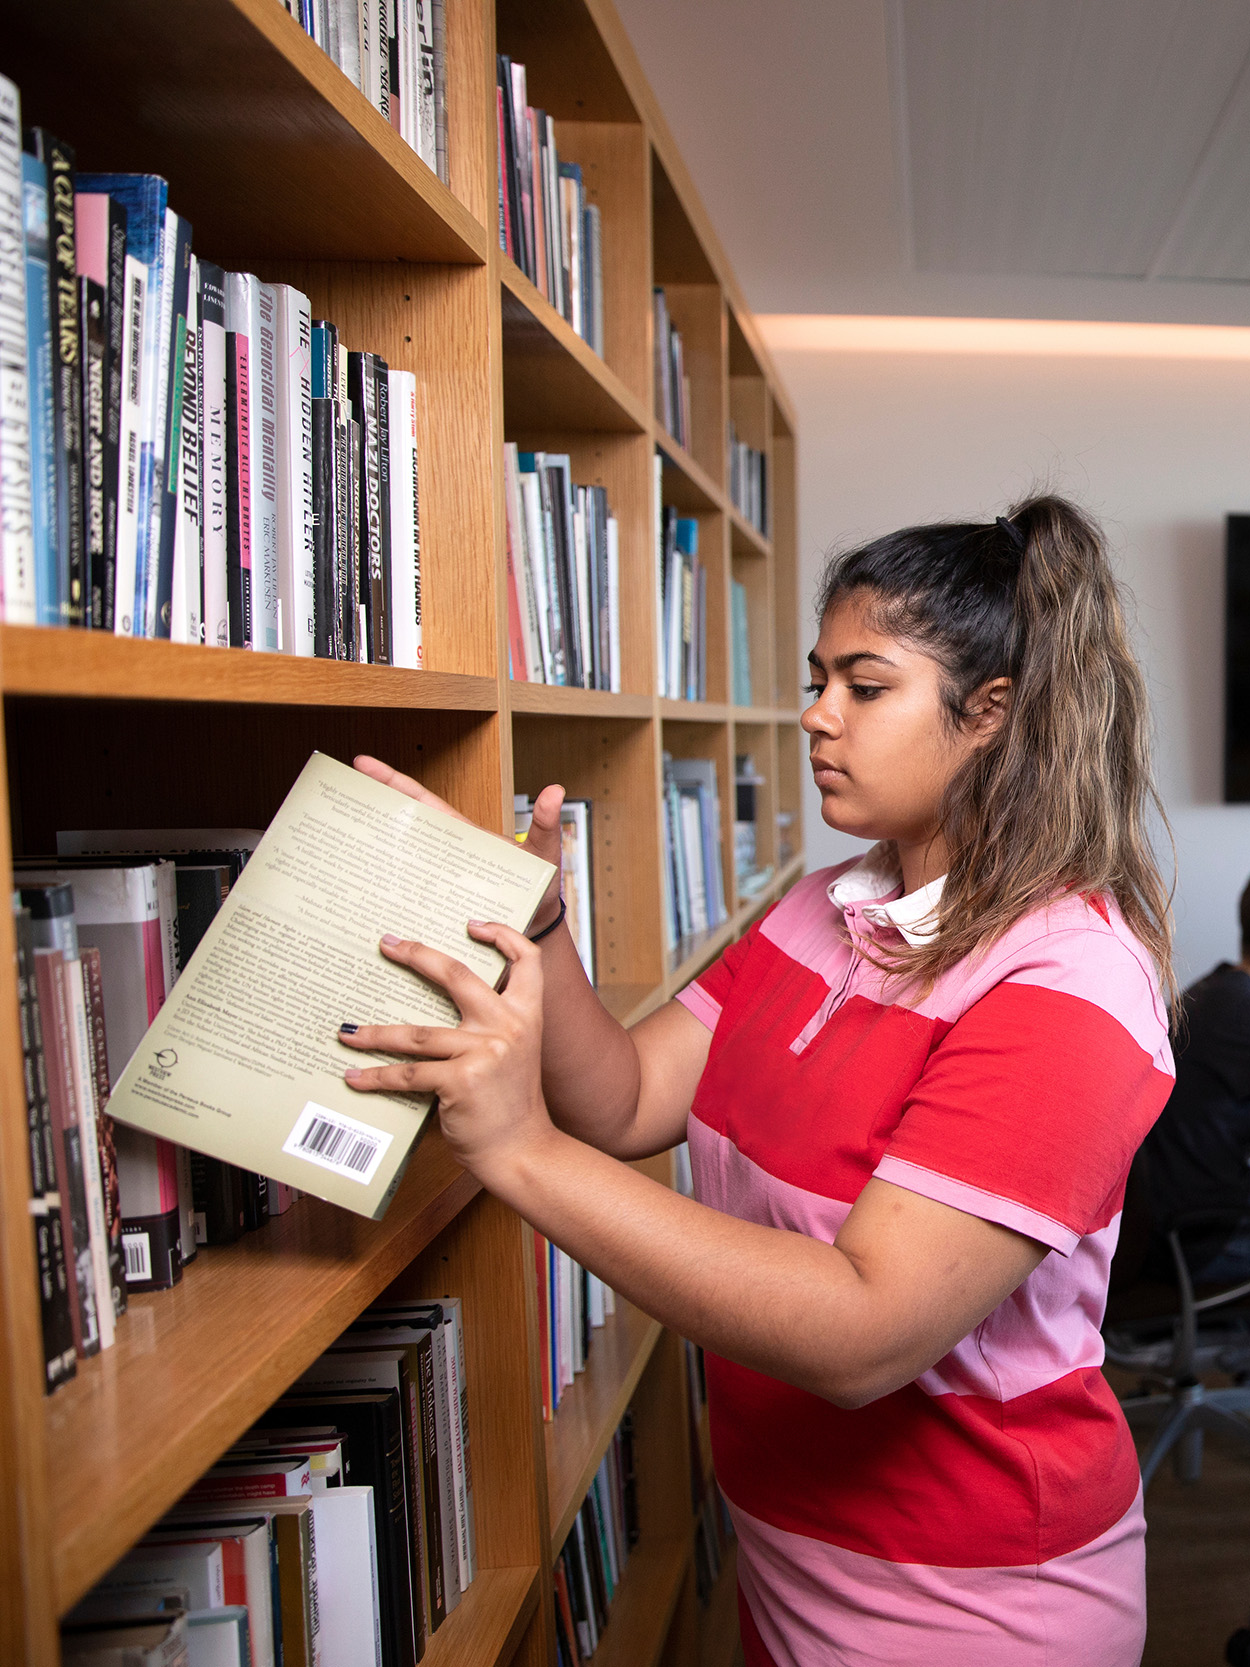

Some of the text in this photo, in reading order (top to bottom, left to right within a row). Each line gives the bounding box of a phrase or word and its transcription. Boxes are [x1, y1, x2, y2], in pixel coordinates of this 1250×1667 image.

[52, 148, 71, 172] A
[54, 174, 75, 236] CUP
[58, 277, 79, 366] TEARS
[259, 291, 276, 503] The Genocidal Mentality
[380, 382, 388, 424] Robert
[89, 356, 104, 555] NIGHT AND HOPE
[299, 309, 313, 553] THE HIDDEN HITLER
[380, 426, 388, 444] Jay
[182, 426, 198, 528] BELIEF
[210, 403, 223, 538] MEMORY
[367, 375, 381, 580] THE NAZI DOCTORS
[264, 546, 272, 611] MARKUSEN
[92, 959, 100, 1005] DARK
[427, 1379, 437, 1458] Holocaust
[439, 1373, 448, 1435] NARRATIVES
[445, 1458, 453, 1515] HOLOCAUST
[308, 1509, 321, 1635] AMERICAN JUDAISM
[448, 1519, 456, 1567] SURVIVAL
[460, 1528, 468, 1561] Newman
